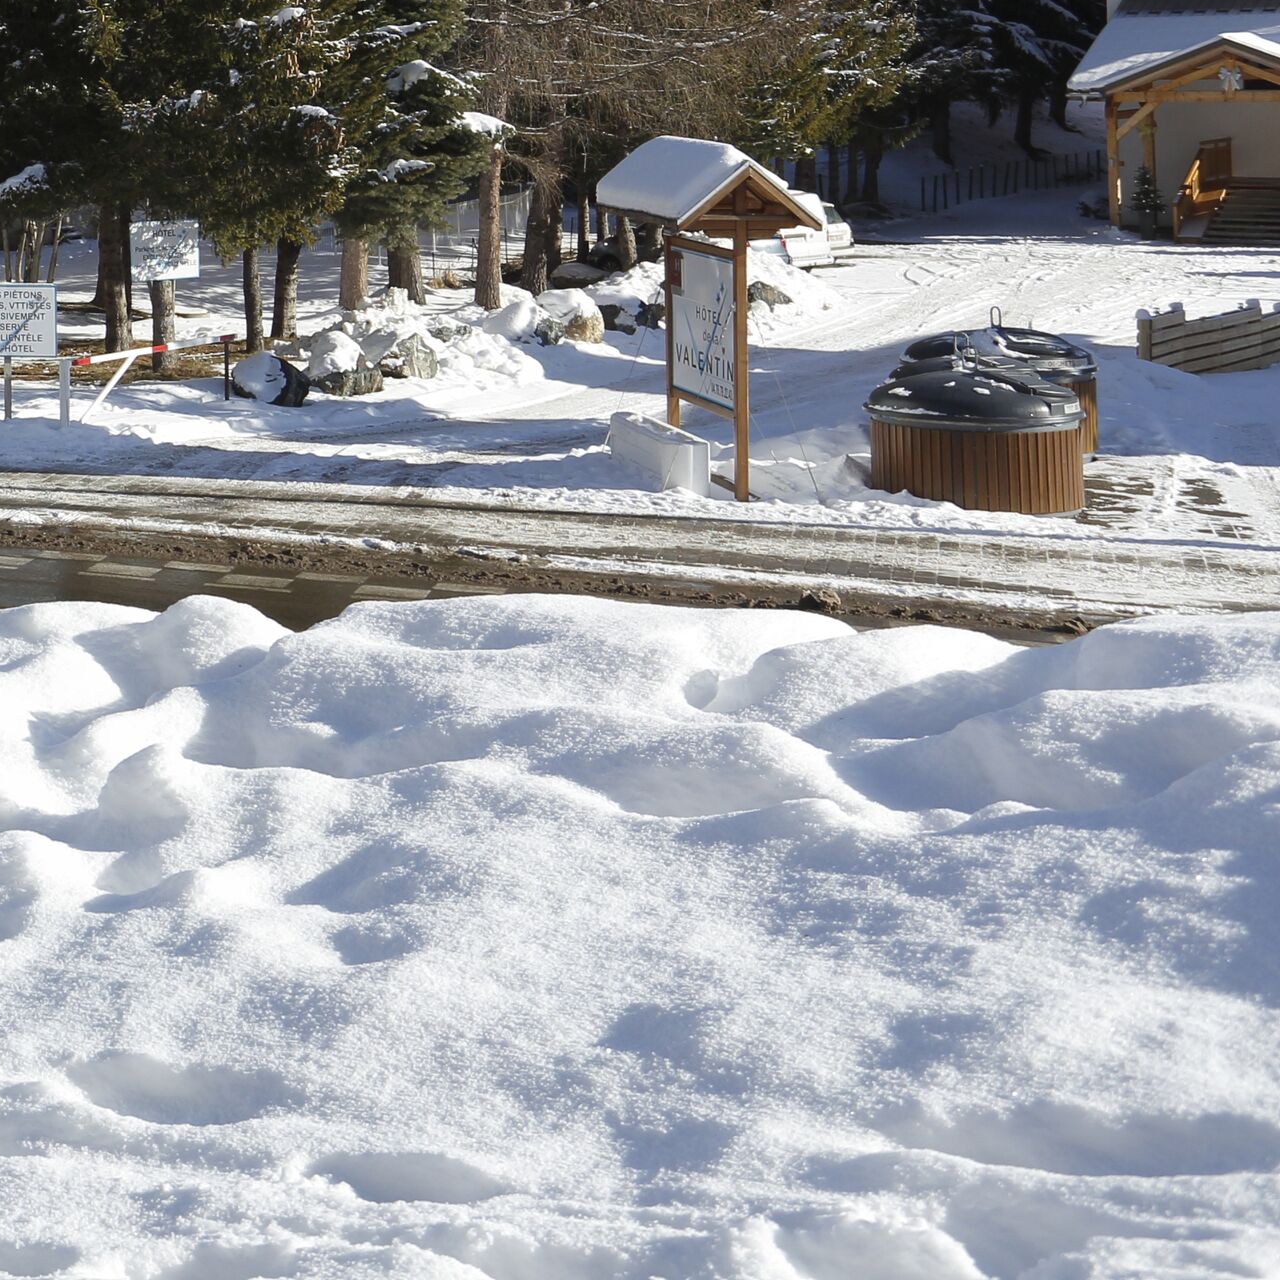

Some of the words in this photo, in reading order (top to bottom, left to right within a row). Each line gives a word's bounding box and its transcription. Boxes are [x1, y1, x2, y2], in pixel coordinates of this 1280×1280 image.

[8, 301, 52, 310] VTTISTES
[695, 304, 722, 327] HÔTEL
[702, 330, 711, 343] de
[675, 341, 735, 382] VALENTIN
